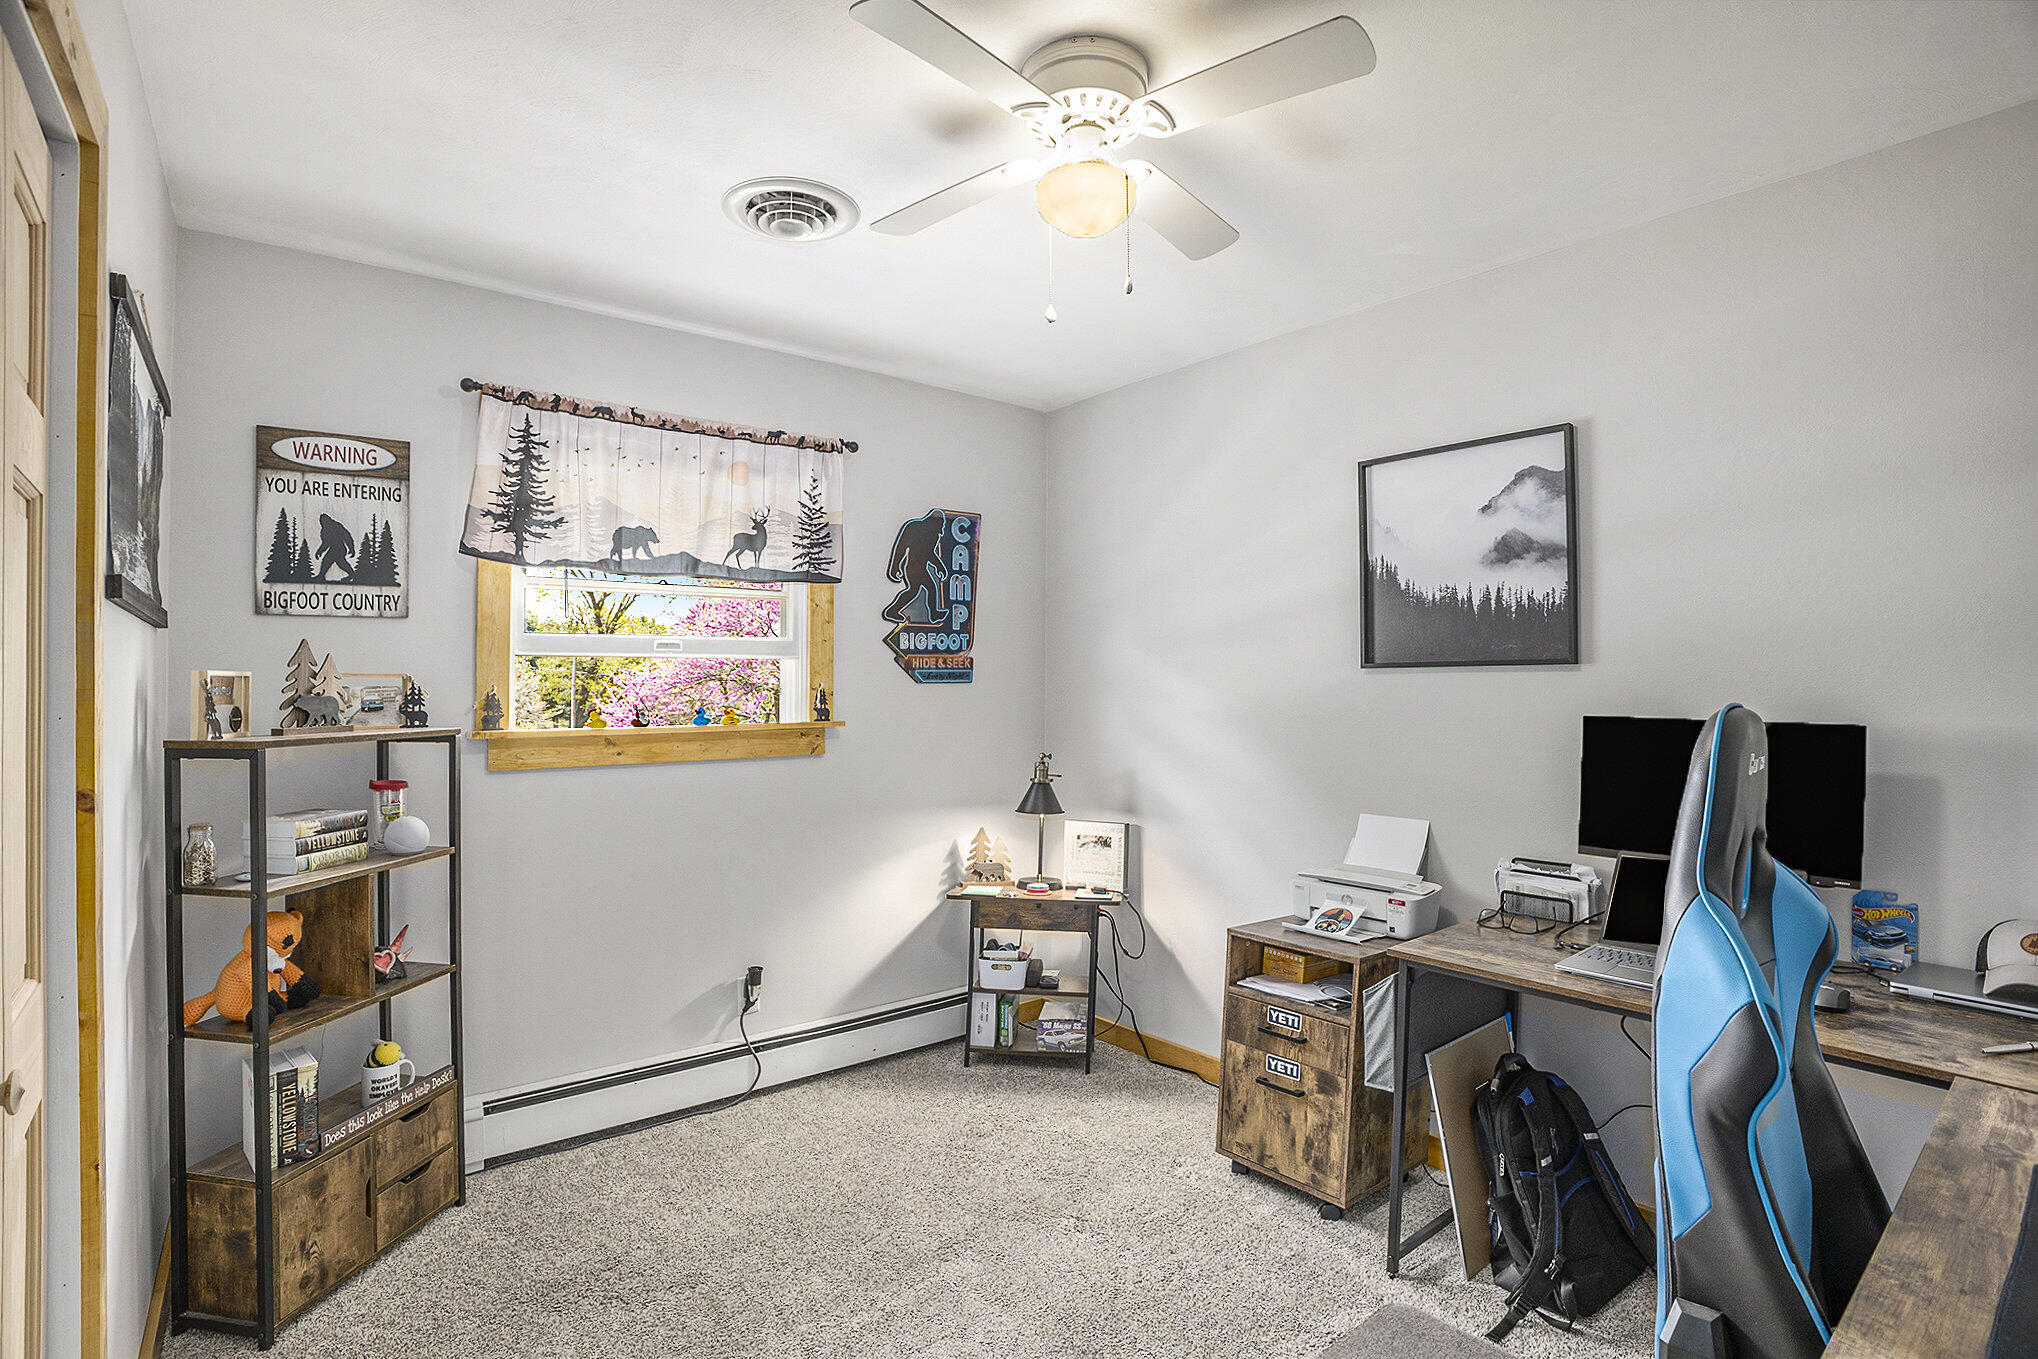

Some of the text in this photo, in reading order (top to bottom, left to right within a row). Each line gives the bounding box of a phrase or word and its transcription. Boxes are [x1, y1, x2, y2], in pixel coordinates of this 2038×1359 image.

[292, 441, 378, 466] WARNING
[265, 477, 402, 503] YOU ARE ENTERING
[949, 516, 972, 631] CAMP
[263, 590, 401, 611] BIGFOOT COUNTRY
[899, 632, 970, 651] BIGFOOT
[912, 657, 971, 668] HIDE & SEEK
[306, 829, 360, 850] YELLOWSTONE
[1270, 1009, 1299, 1028] YETI
[1268, 1057, 1298, 1077] YETI
[282, 1082, 298, 1154] YELLOWSTONE
[324, 1127, 346, 1147] Does
[348, 1116, 365, 1134] this
[366, 1106, 383, 1124] look
[384, 1099, 400, 1115] like
[400, 1092, 413, 1105] the
[414, 1082, 431, 1098] Help
